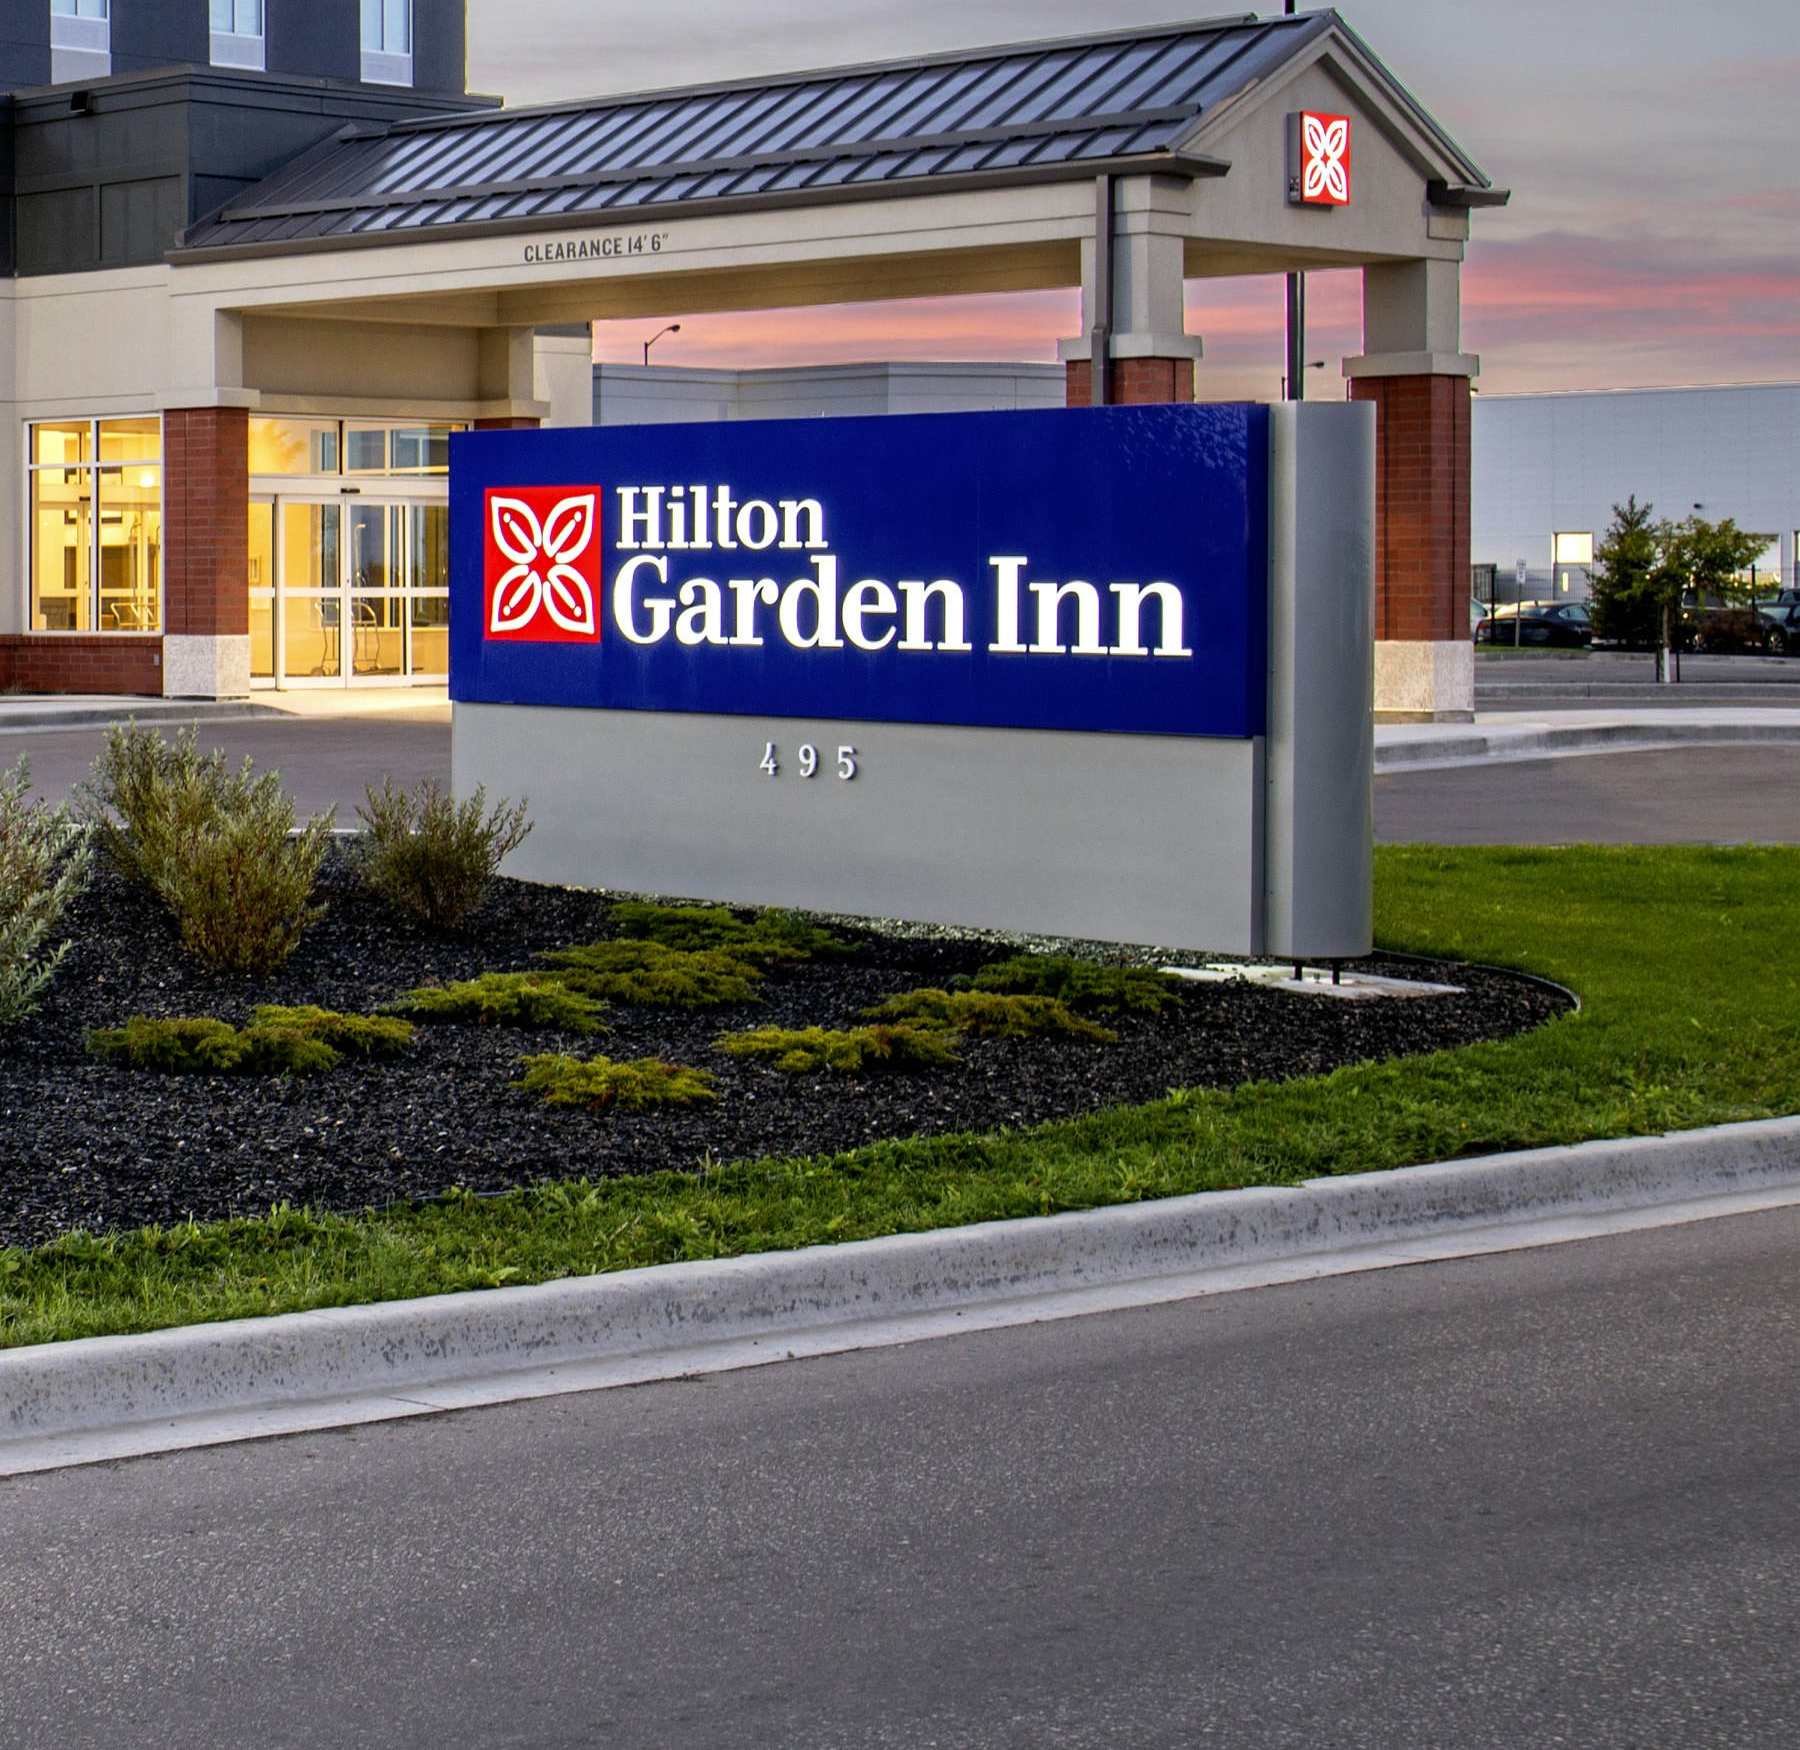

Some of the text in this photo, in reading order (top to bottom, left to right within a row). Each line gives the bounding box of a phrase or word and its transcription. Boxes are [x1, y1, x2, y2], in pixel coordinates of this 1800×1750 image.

[524, 237, 623, 262] CLEARANCE
[615, 485, 829, 549] Hilton
[612, 554, 1193, 657] Garden Inn
[759, 741, 859, 780] 495
